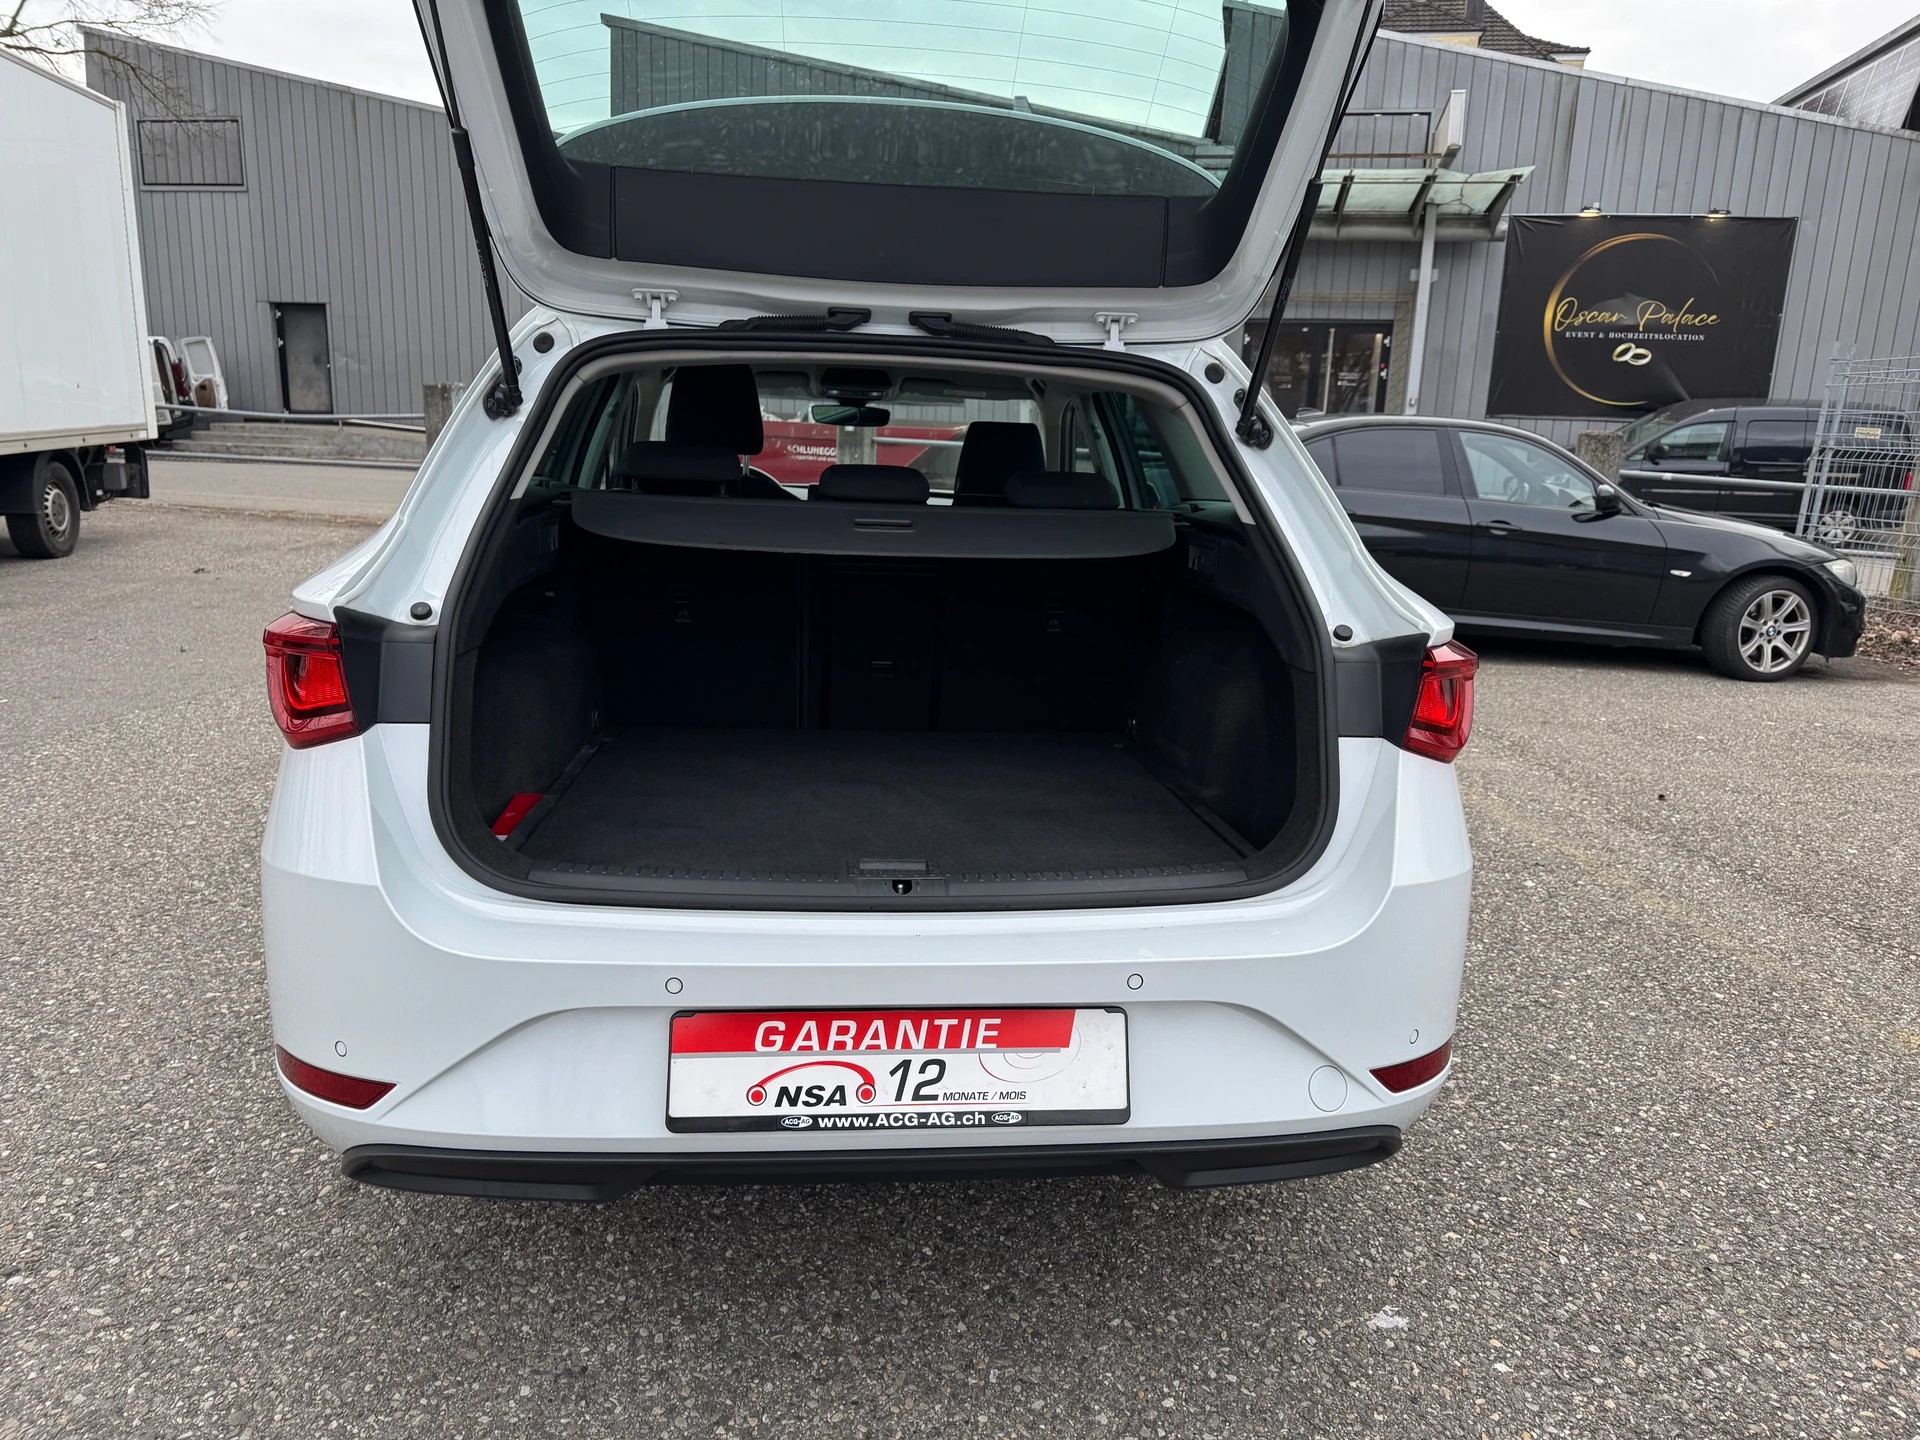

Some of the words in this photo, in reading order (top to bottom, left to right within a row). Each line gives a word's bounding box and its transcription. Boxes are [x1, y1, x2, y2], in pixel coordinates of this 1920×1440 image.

[1554, 297, 1627, 332] Oscar
[1636, 297, 1720, 333] Palace
[1565, 331, 1596, 339] EVENT
[1608, 332, 1705, 341] HOCHZEITSLOCATION
[754, 1018, 1002, 1052] GARANTIE
[888, 1058, 947, 1102] 12
[942, 1091, 989, 1102] MONATE
[998, 1090, 1027, 1101] MOIS
[774, 1085, 847, 1108] NSA
[784, 1117, 811, 1125] ACG-AG
[817, 1112, 986, 1128] www.ACG-AG.ch
[994, 1114, 1020, 1122] ACG-AG
